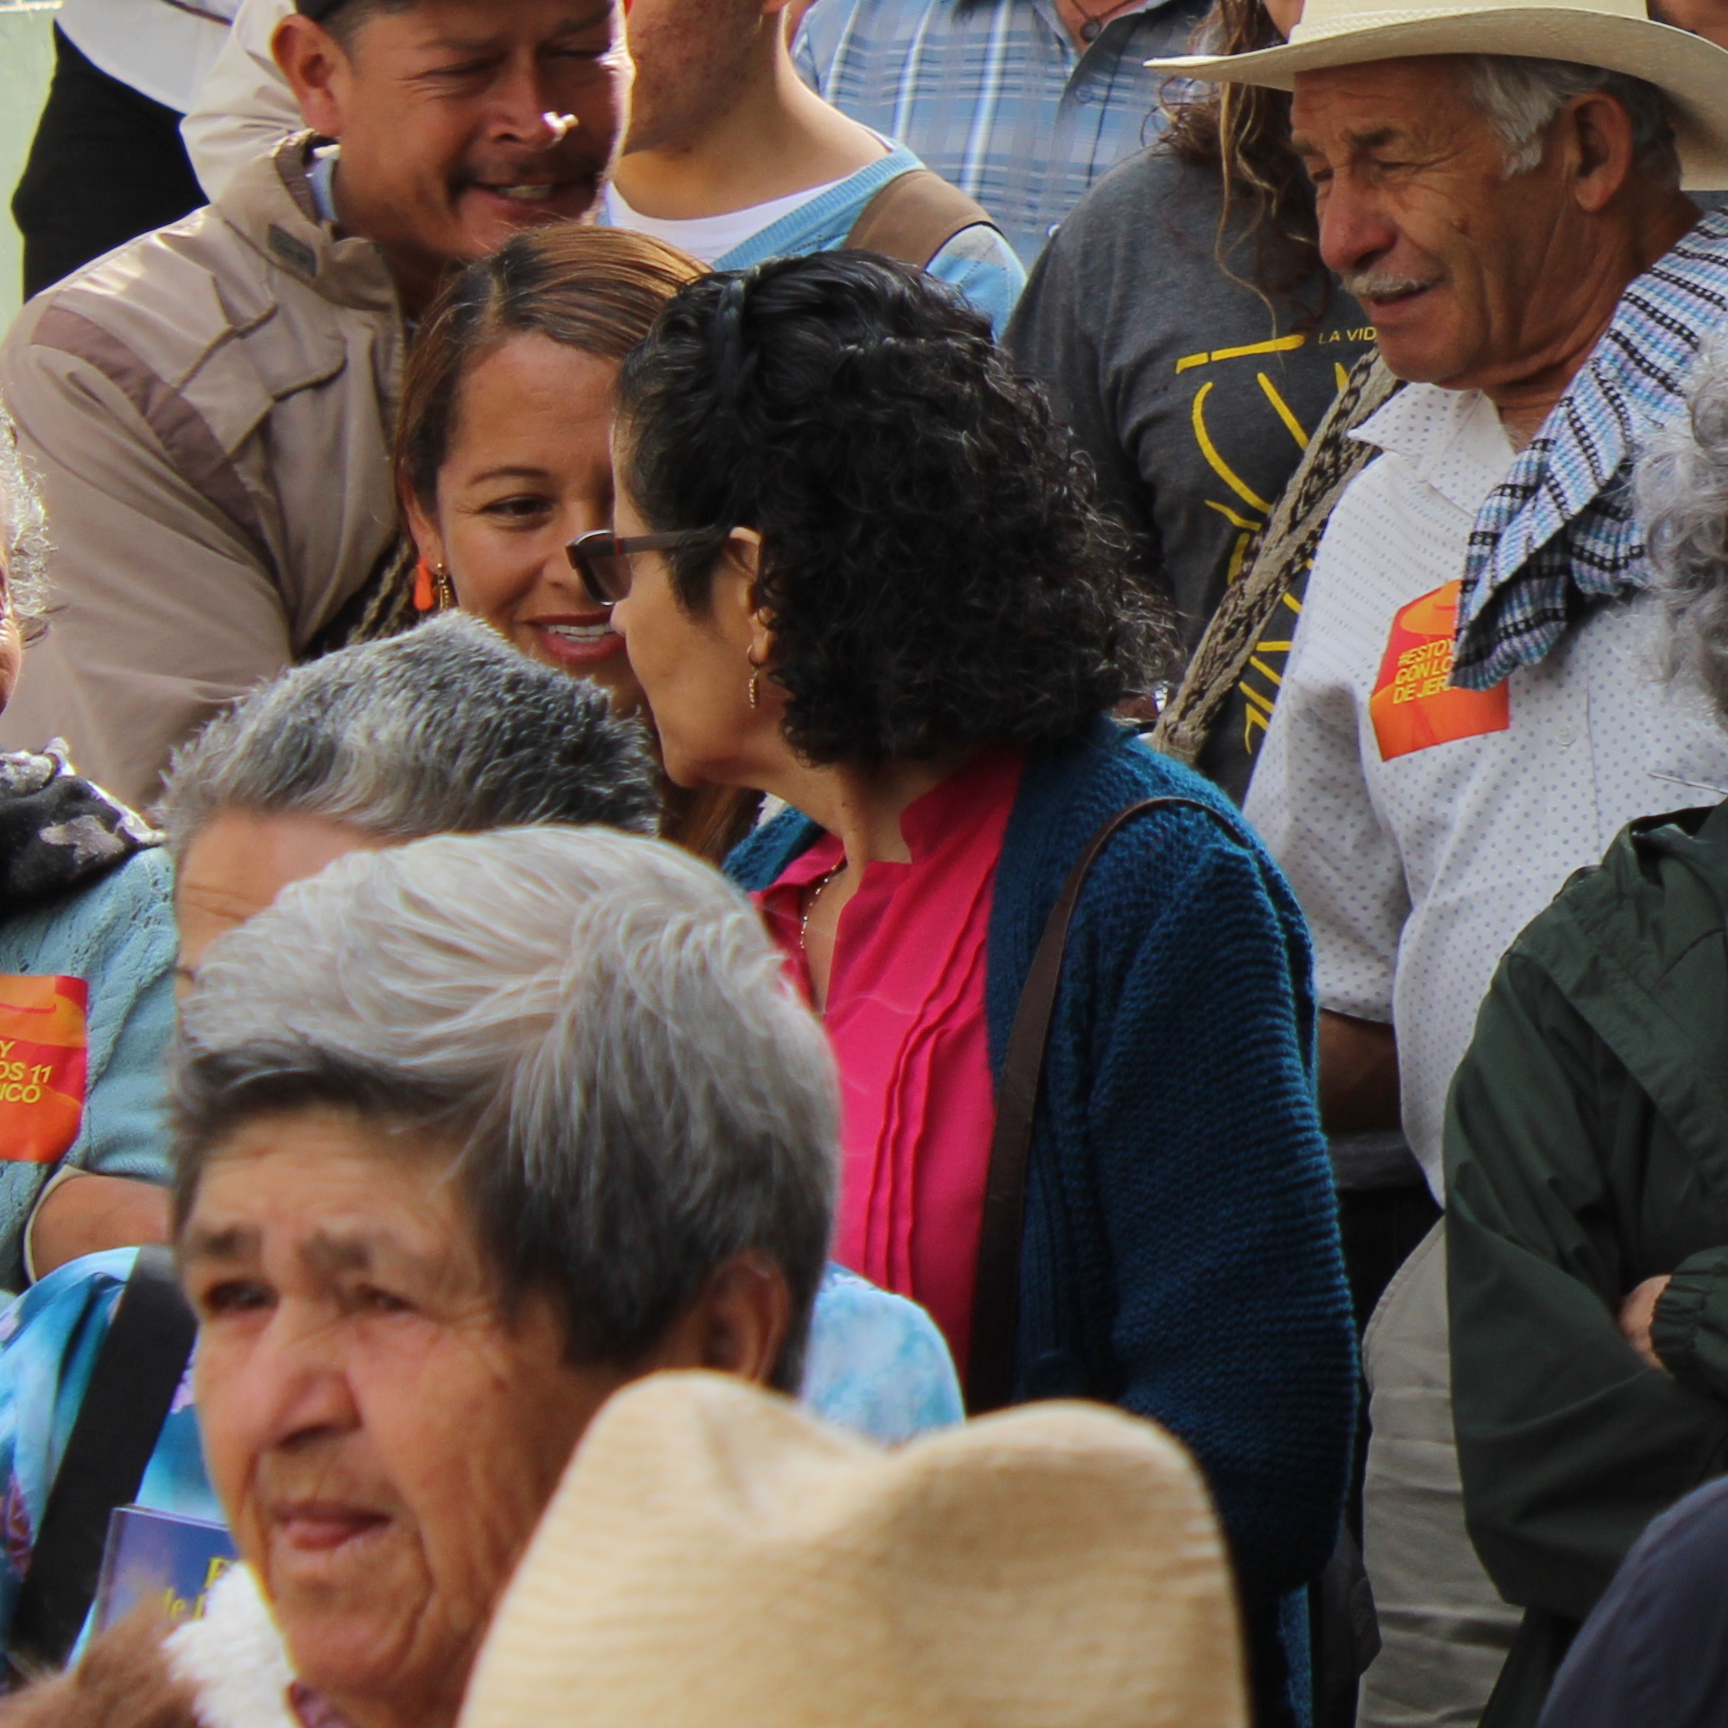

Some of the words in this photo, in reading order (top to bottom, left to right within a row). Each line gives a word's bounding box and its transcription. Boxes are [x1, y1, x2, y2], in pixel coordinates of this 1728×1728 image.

[1319, 331, 1340, 345] LA
[1396, 662, 1429, 685] CON
[1393, 683, 1417, 704] DE
